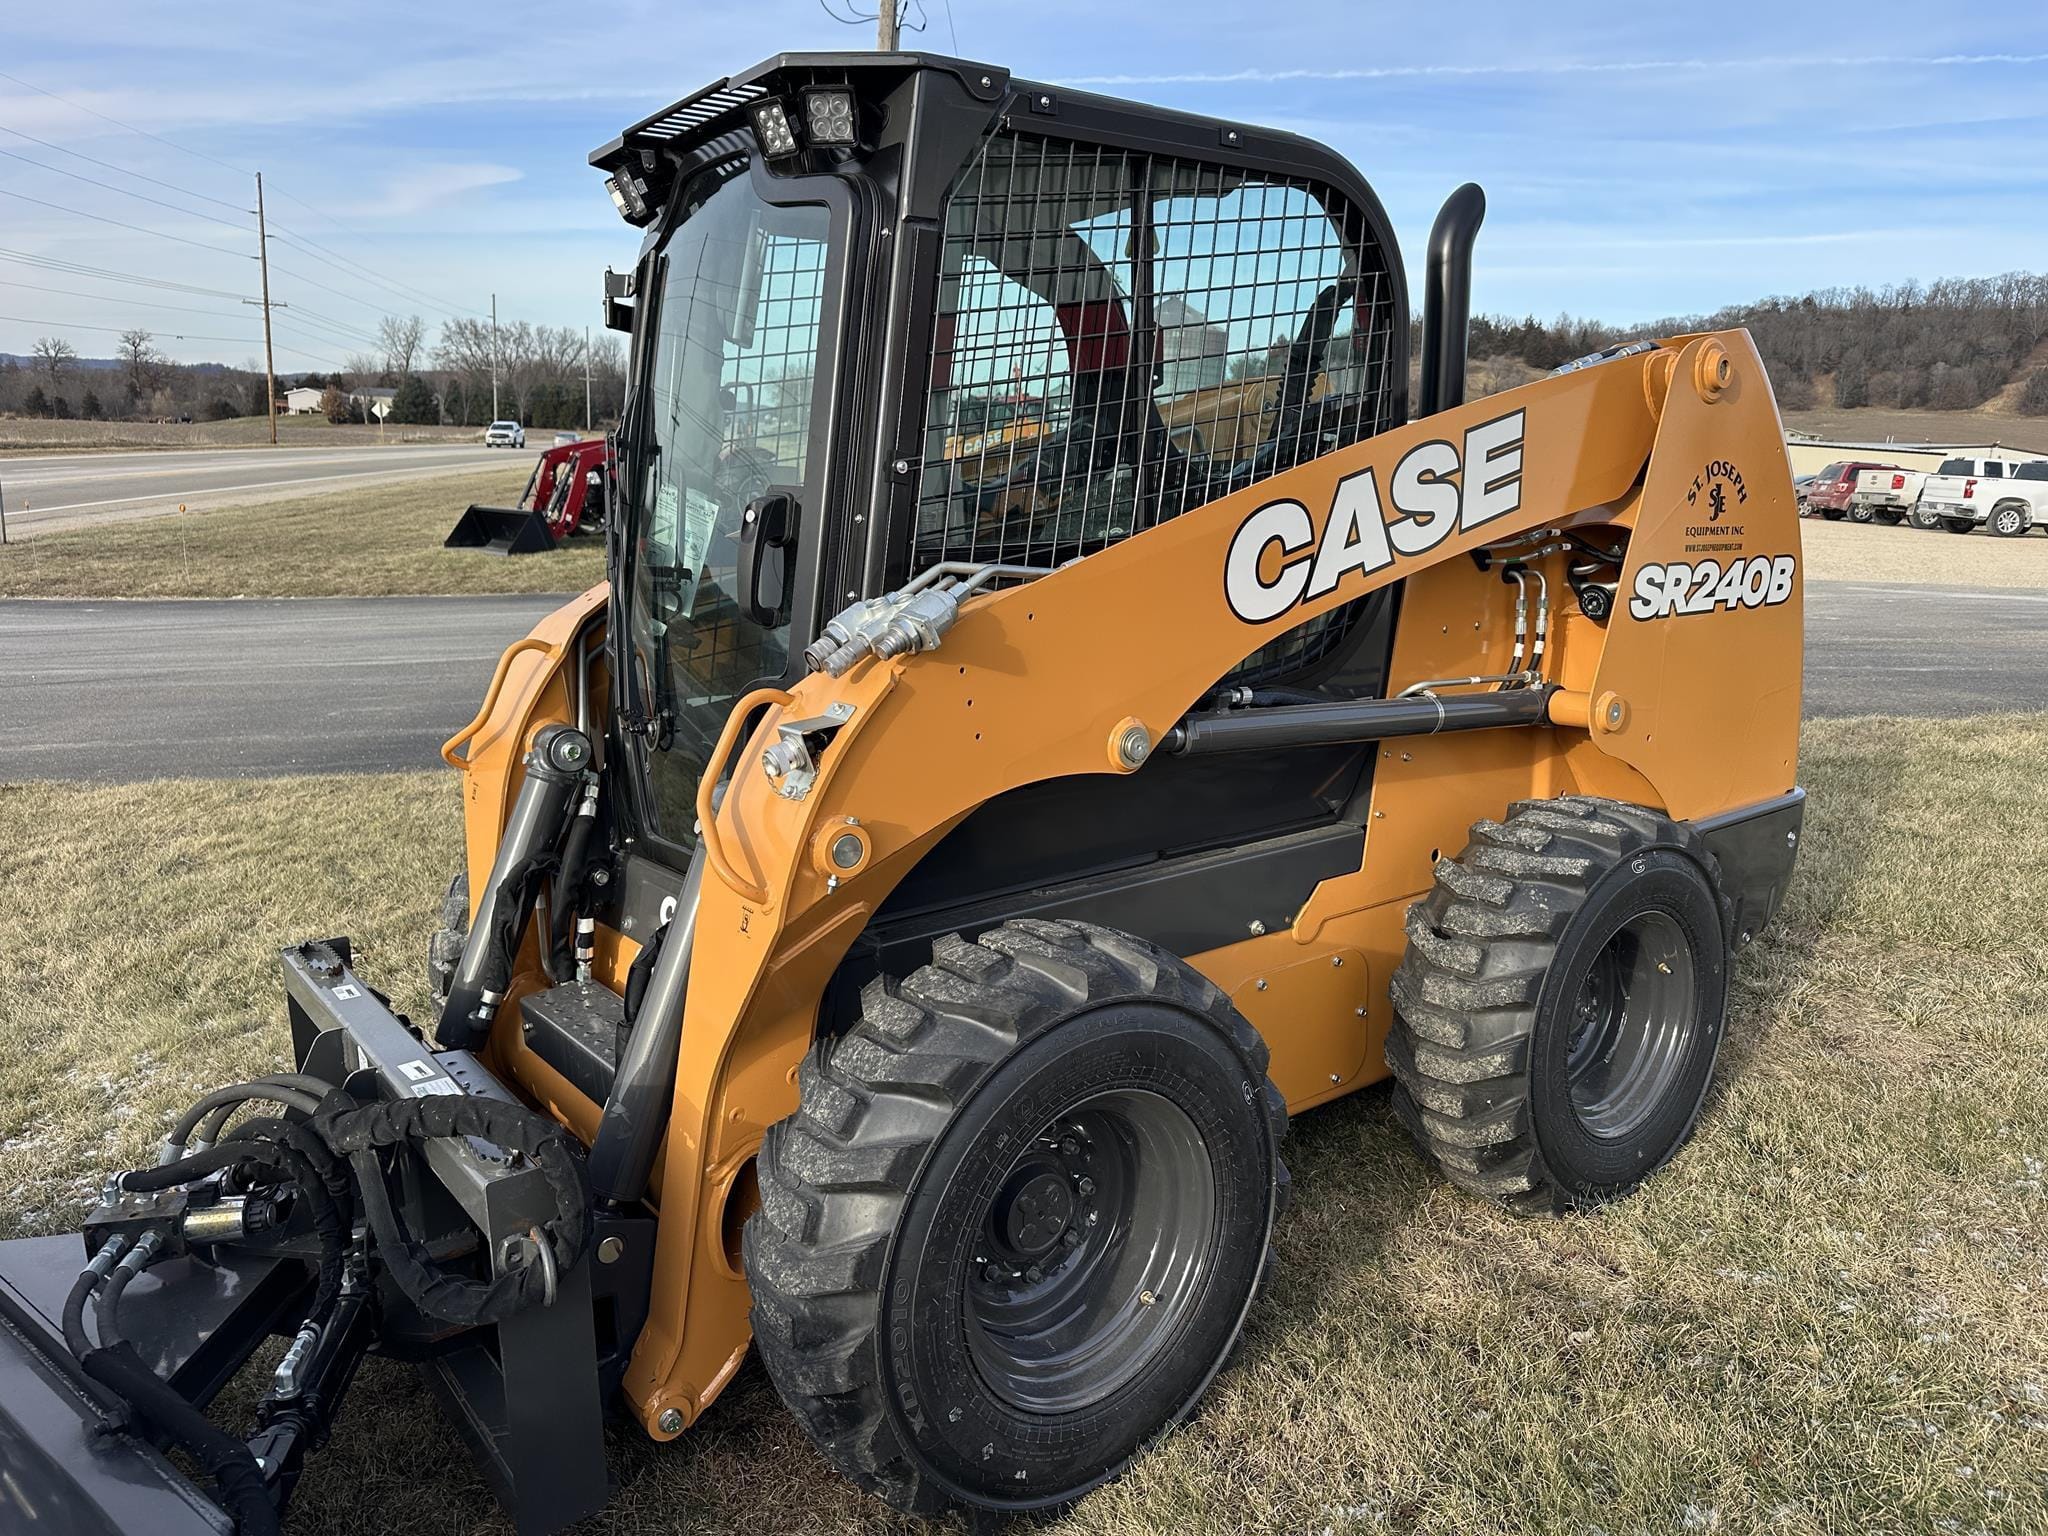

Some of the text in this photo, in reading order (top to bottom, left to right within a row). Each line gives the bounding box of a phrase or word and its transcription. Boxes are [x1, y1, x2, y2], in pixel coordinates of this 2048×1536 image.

[1224, 407, 1526, 624] CASE
[1687, 460, 1748, 507] ST. JOSEPH
[1685, 525, 1745, 538] EQUIPMENT INC
[1629, 554, 1796, 622] SR240B
[890, 1278, 930, 1438] XD2010
